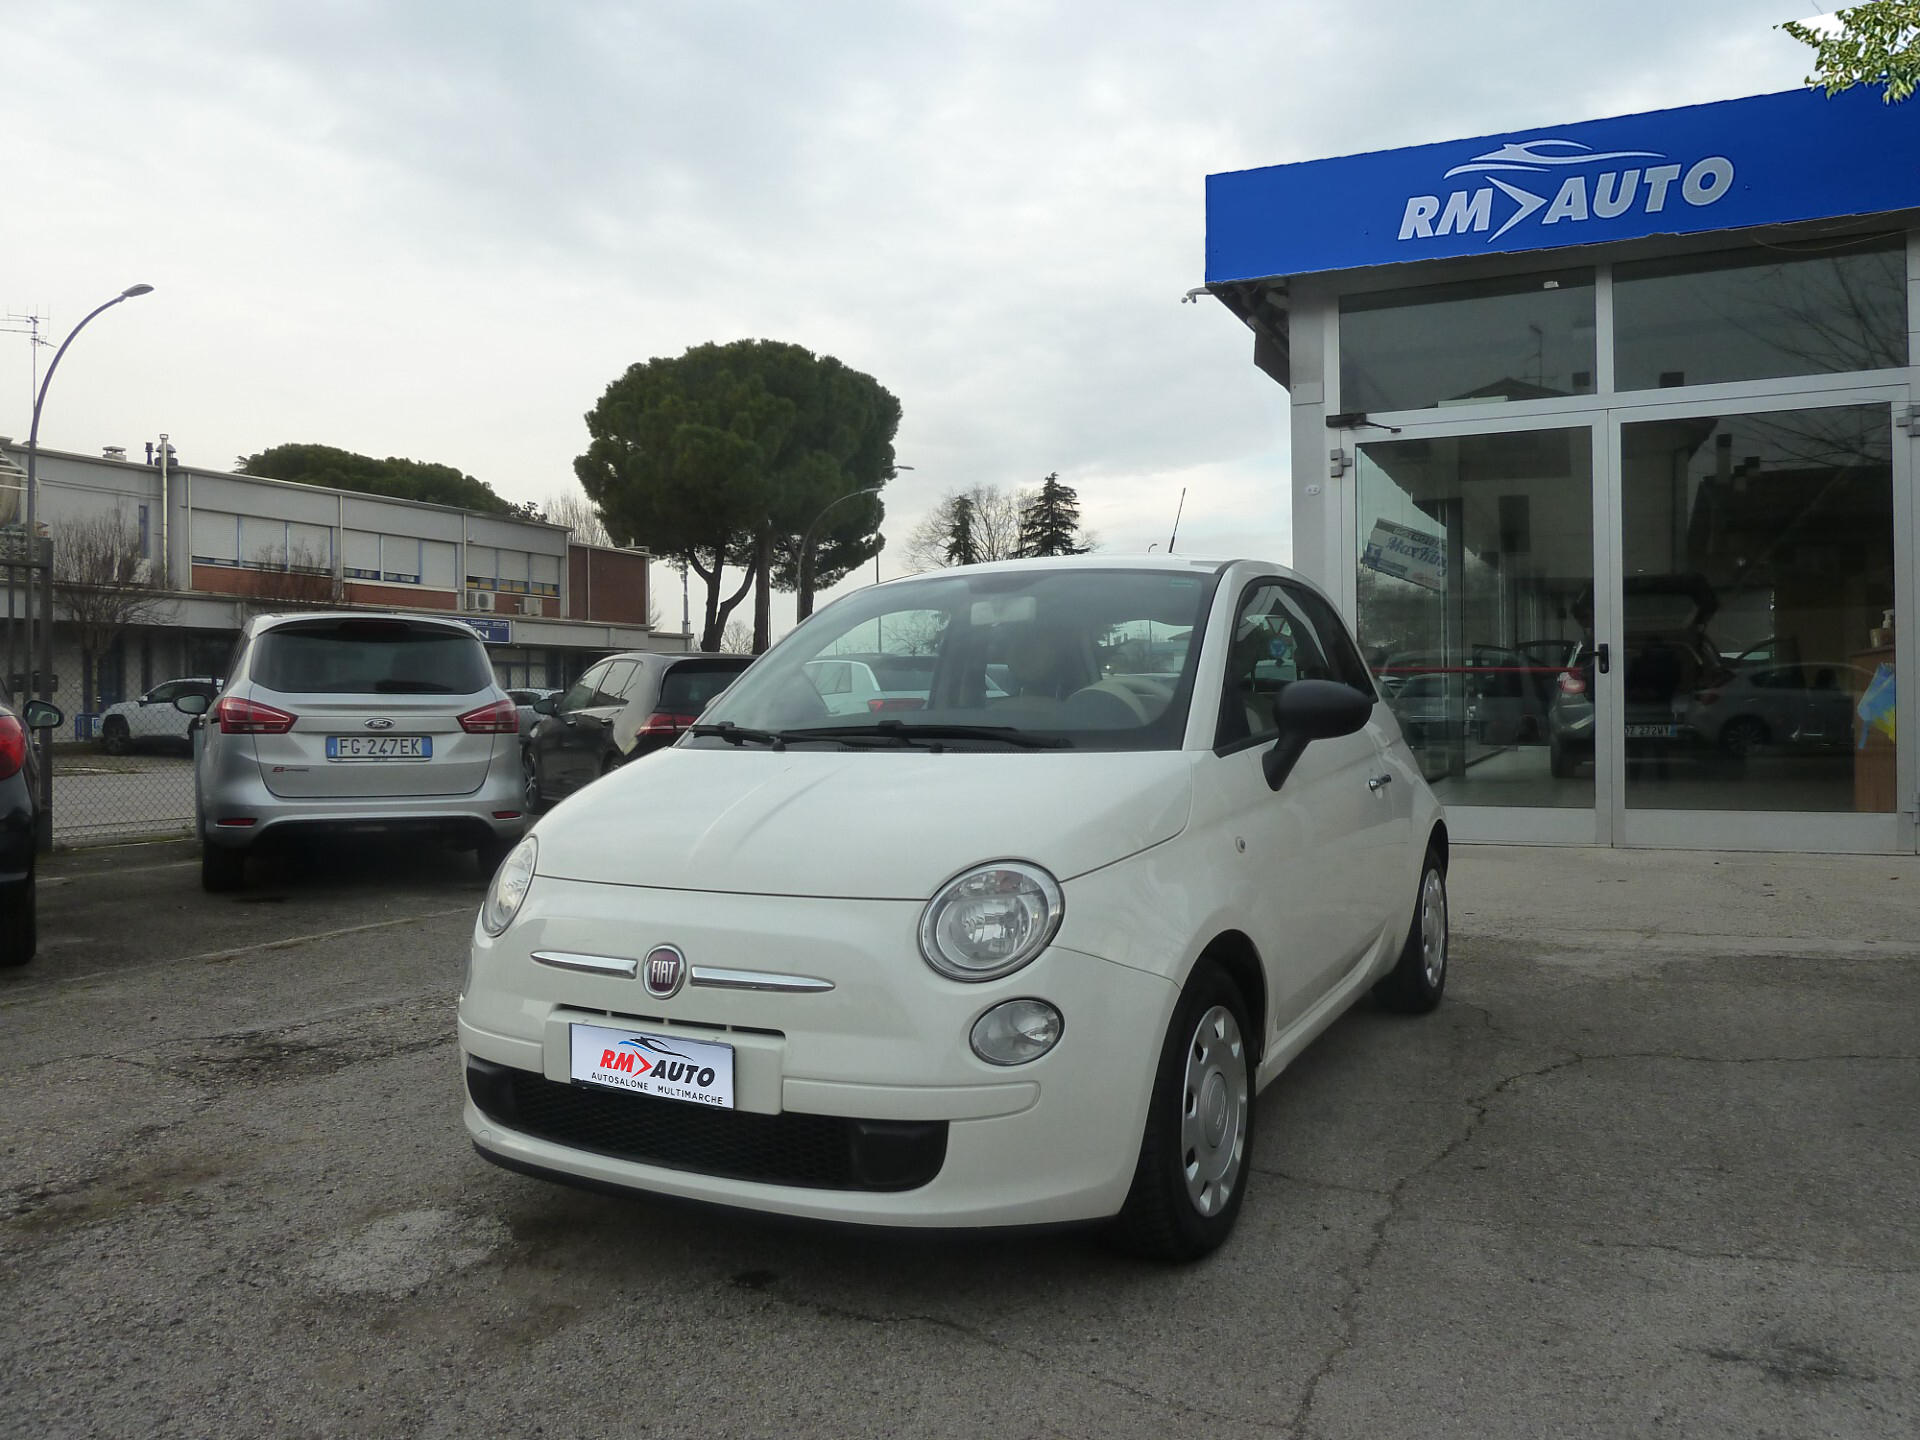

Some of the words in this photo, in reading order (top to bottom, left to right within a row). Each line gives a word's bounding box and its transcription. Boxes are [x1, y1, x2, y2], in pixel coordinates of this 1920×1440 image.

[1397, 187, 1495, 241] RM
[1541, 156, 1735, 225] AUTO
[339, 738, 361, 755] FG
[367, 738, 421, 755] 247EK
[651, 960, 677, 984] FIAT
[600, 1049, 635, 1073] RM
[649, 1059, 716, 1087] AUTO
[591, 1072, 649, 1090] AUTOSALONE
[657, 1085, 724, 1105] MULTIMARCHE
